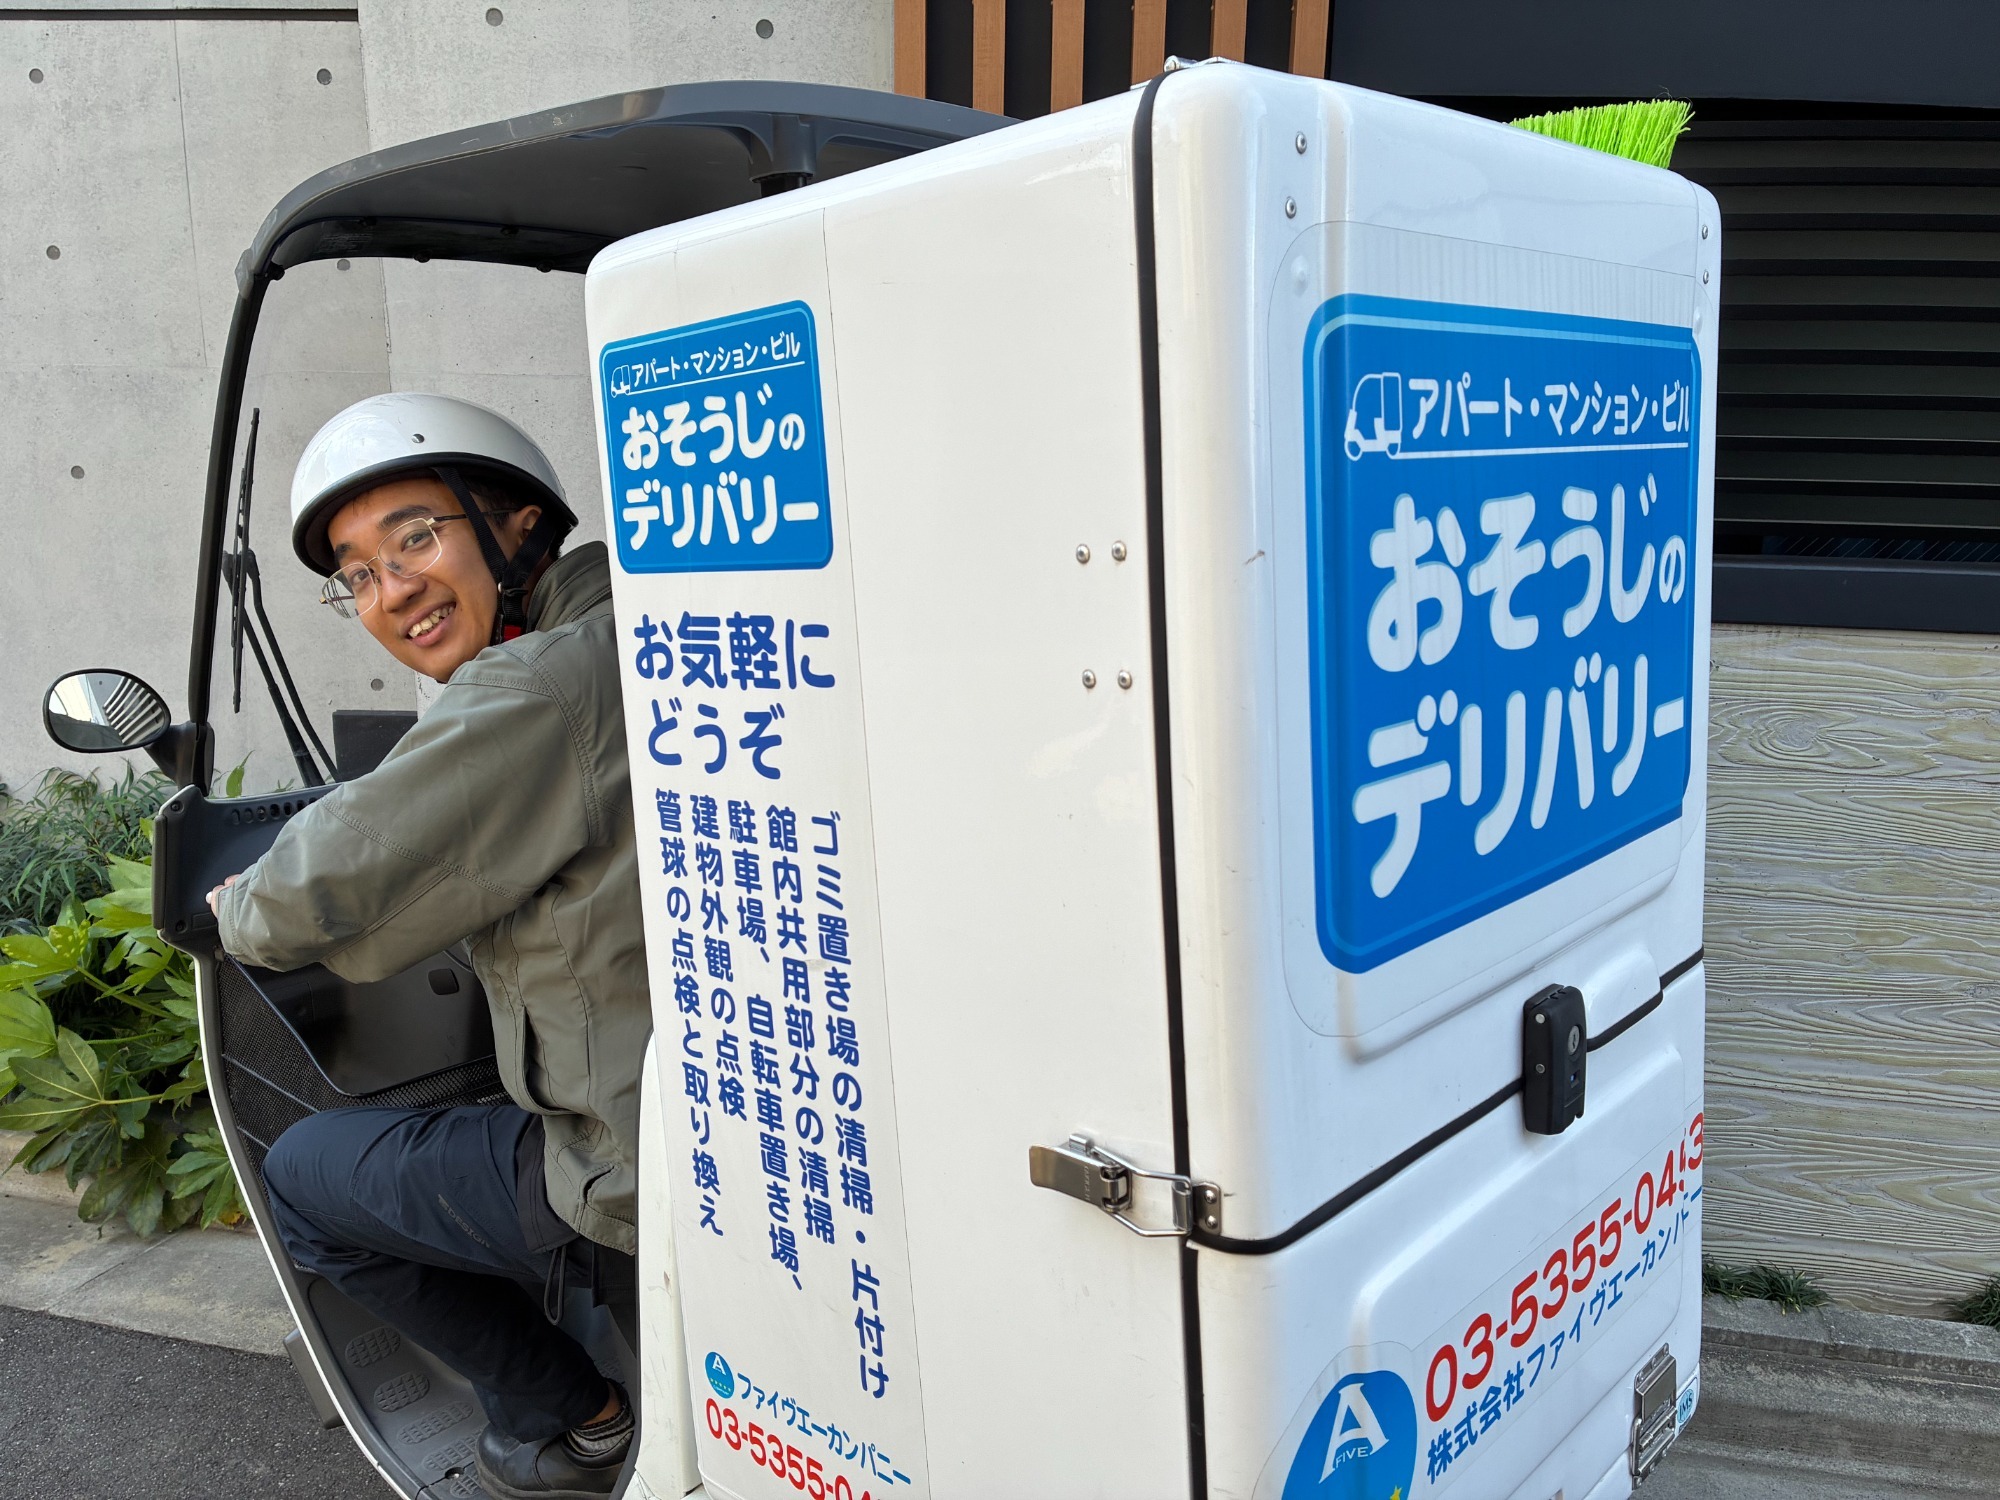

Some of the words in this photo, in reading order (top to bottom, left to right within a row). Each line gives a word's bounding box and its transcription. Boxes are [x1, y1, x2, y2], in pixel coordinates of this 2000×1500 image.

[631, 331, 801, 387] アパート・マンション・ビル
[1409, 372, 1690, 439] アパート・マンション・ビル
[622, 383, 806, 471] おそうじの
[623, 471, 819, 551] デリバリー
[1367, 473, 1687, 673] おそうじの
[633, 611, 836, 691] お気軽に
[648, 697, 785, 780] どうぞ
[1353, 652, 1684, 899] デリバリー
[690, 794, 748, 1122] 建物外観の点検
[655, 788, 724, 1236] 管球の点検と取り換え
[766, 804, 835, 1244] 館内共用部分の清掃
[811, 811, 889, 1399] ゴミ置き場の清掃・片付け
[706, 1398, 872, 1500] 03-5355-0
[1335, 1446, 1369, 1469] FIVE
